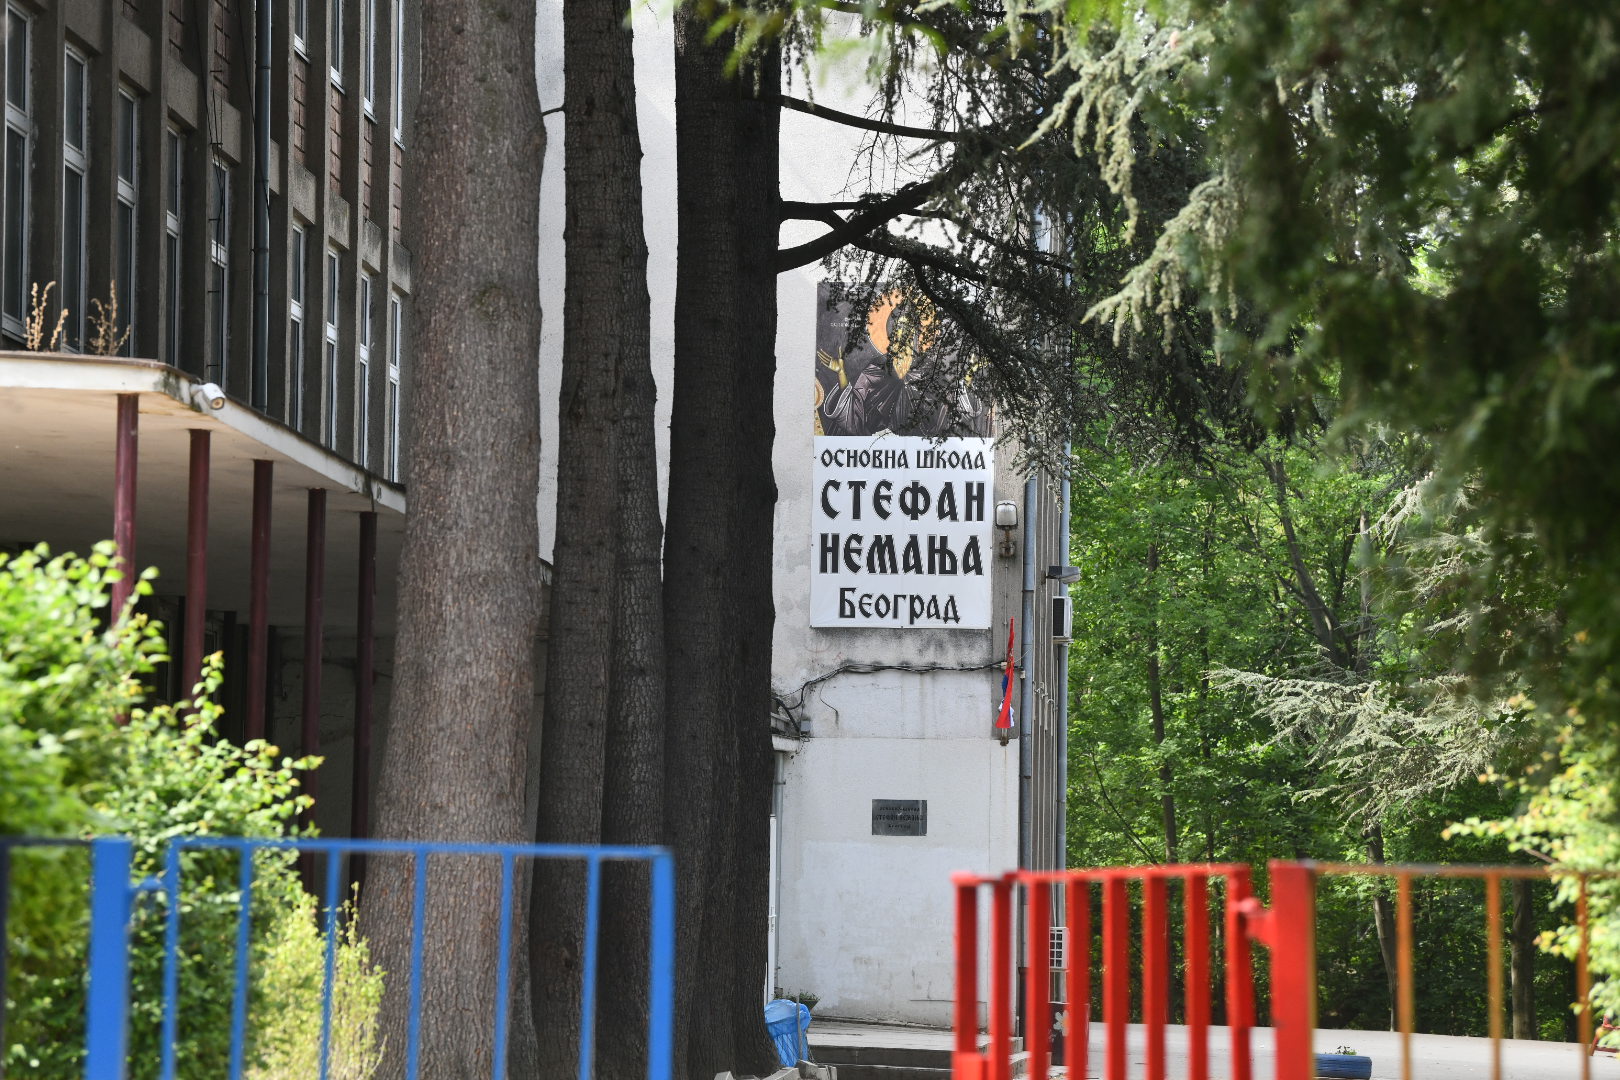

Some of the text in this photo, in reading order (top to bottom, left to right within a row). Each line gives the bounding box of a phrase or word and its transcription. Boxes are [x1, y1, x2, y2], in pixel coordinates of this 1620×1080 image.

[820, 448, 986, 470] ОСНОВНА ШКОЛА
[821, 479, 985, 522] СТЕФАН
[819, 533, 985, 576] НЕМАЊА
[838, 587, 961, 625] Београд
